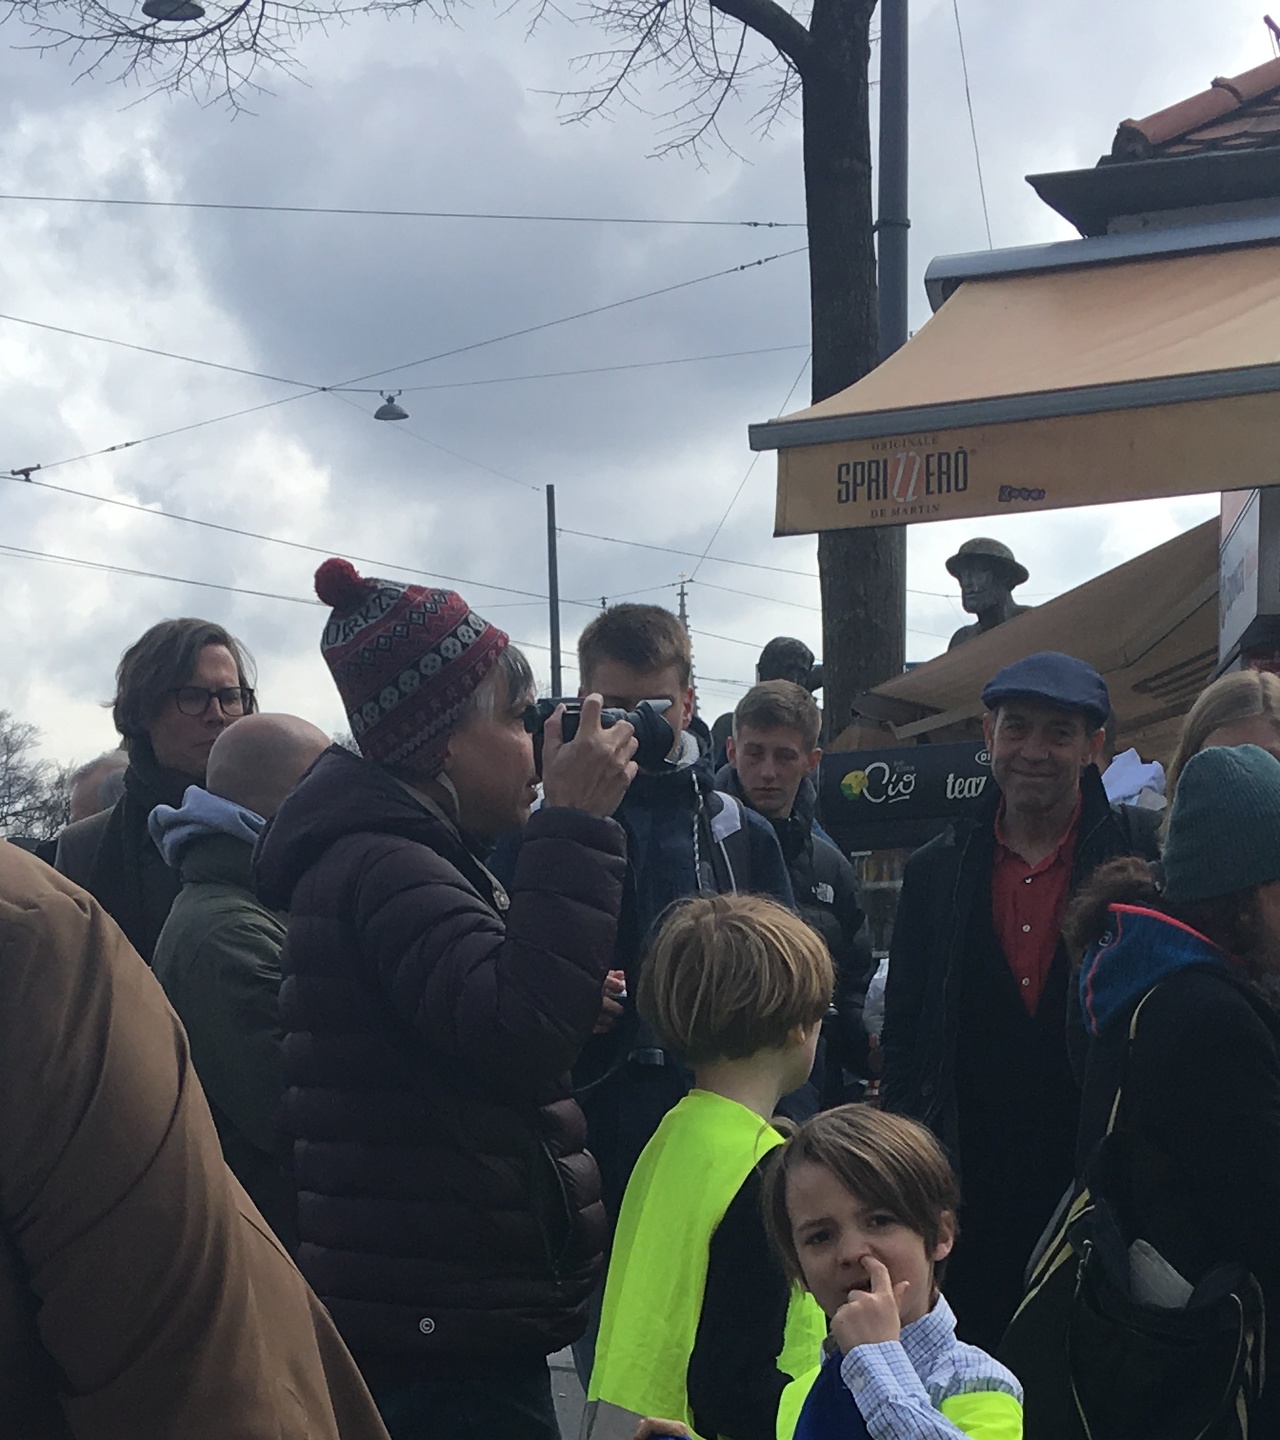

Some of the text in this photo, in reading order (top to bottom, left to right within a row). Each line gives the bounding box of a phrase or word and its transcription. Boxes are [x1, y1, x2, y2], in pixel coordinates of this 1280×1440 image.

[871, 437, 939, 451] ORIGINALE
[871, 504, 940, 519] DE MARTIN
